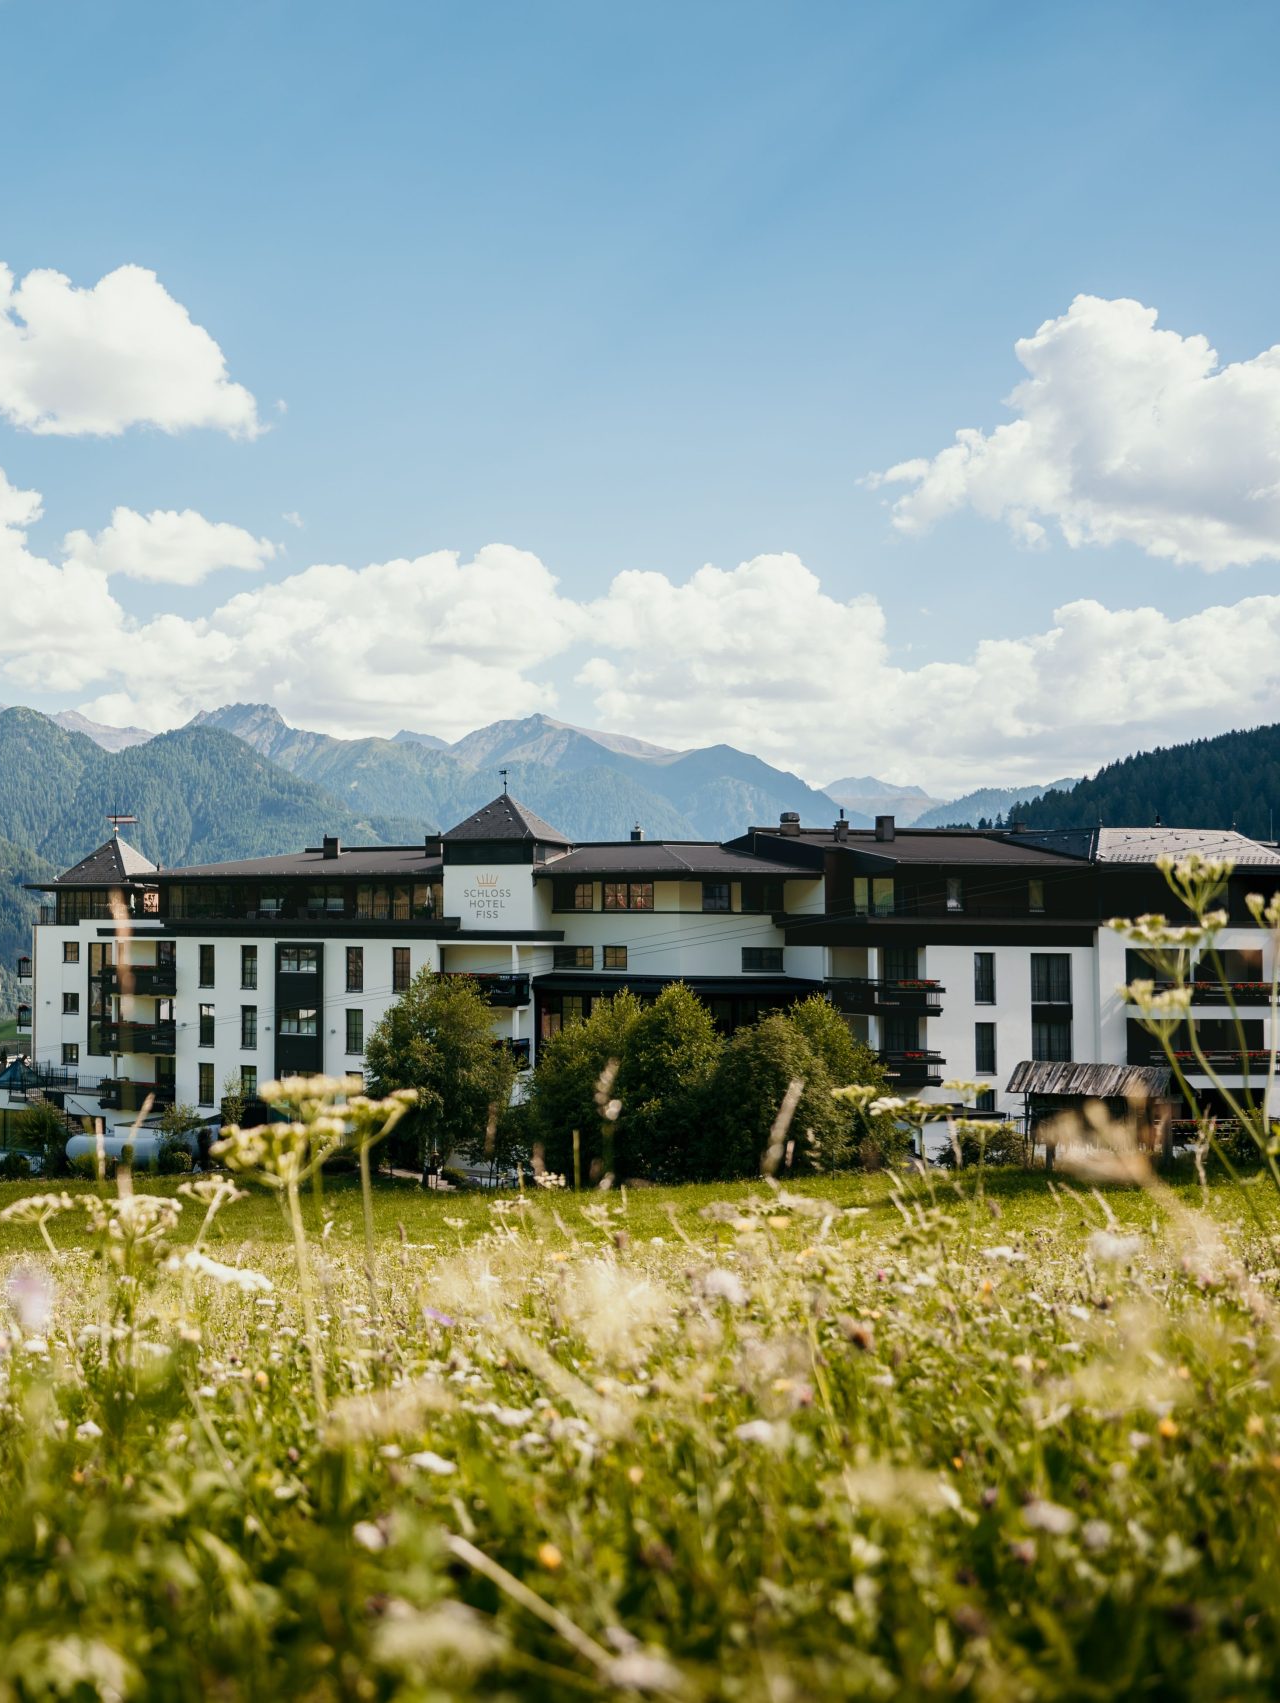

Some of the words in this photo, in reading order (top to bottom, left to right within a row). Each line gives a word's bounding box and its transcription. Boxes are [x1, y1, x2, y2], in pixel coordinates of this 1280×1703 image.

[463, 889, 512, 898] SCHLOSS
[469, 899, 506, 909] HOTEL
[476, 910, 499, 919] FISS
